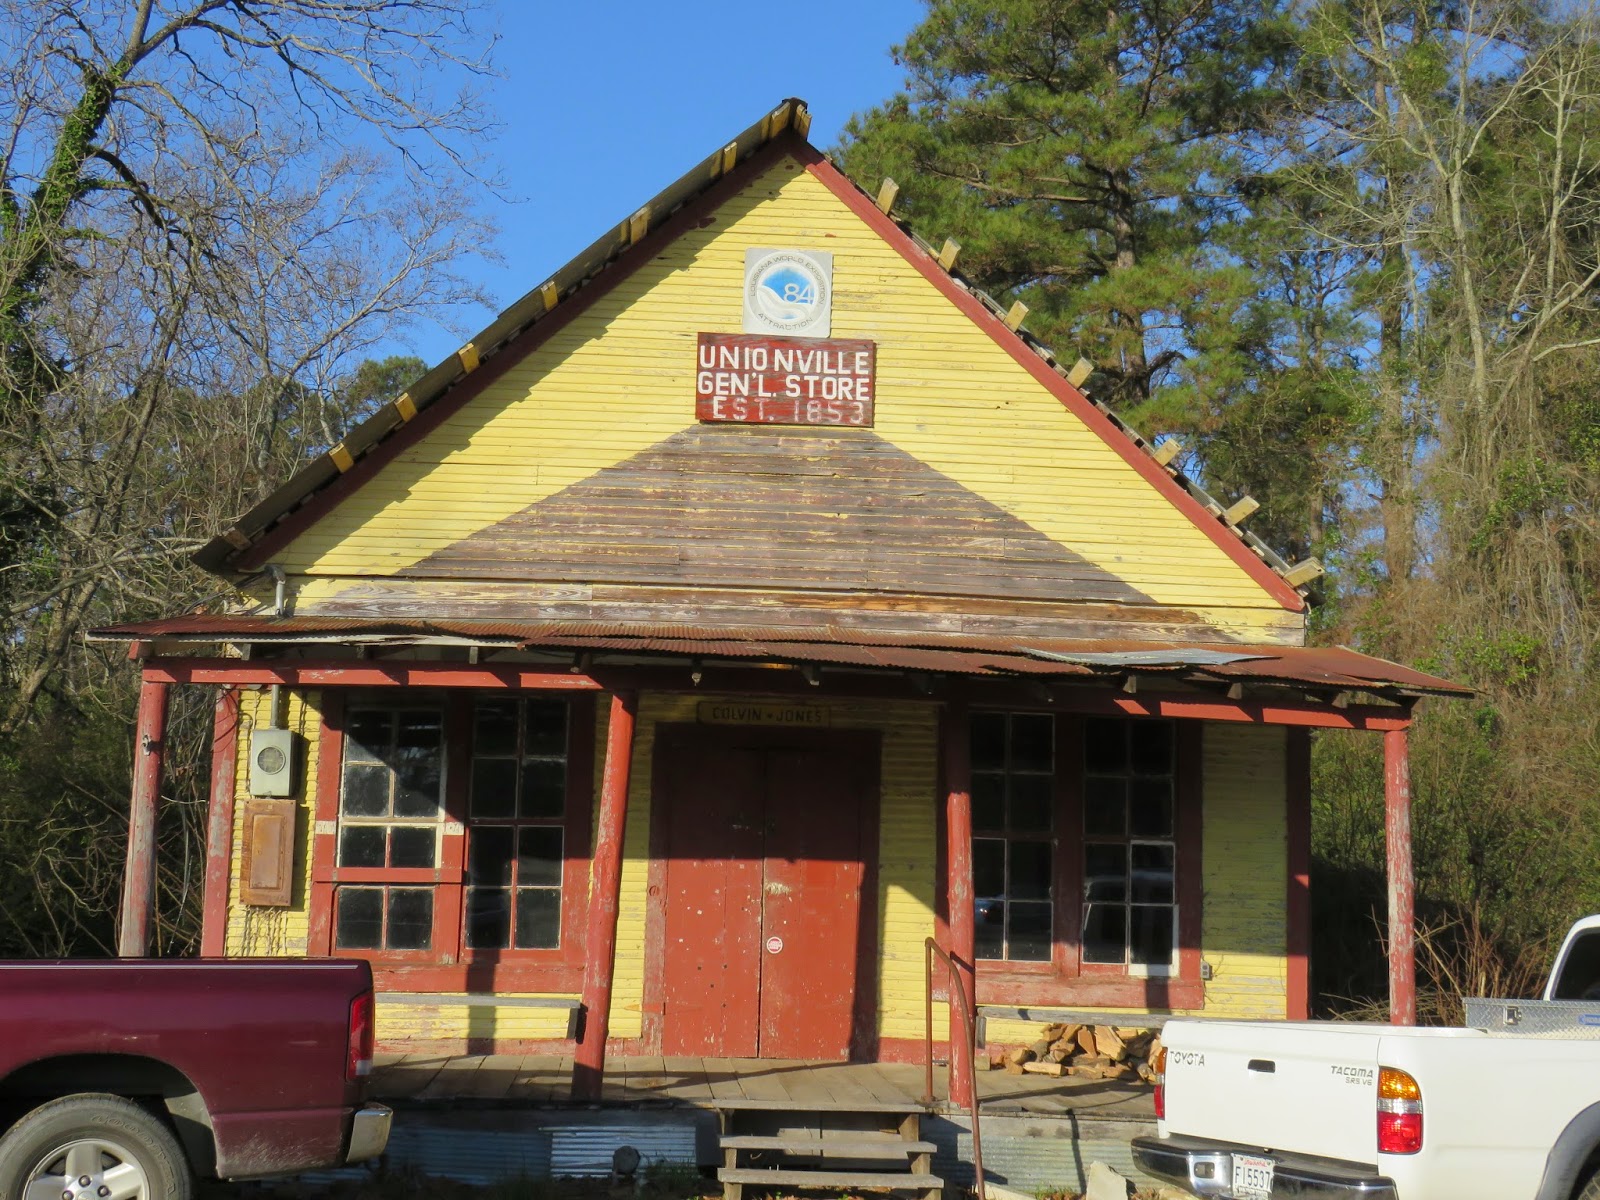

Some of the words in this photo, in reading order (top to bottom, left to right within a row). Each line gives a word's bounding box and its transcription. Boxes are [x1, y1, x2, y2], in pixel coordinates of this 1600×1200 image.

[751, 260, 773, 297] LOUISIANA
[773, 255, 804, 264] WORLD
[805, 263, 828, 305] EXPOSITION
[783, 283, 814, 304] 84
[758, 312, 814, 331] ATTRACTION
[700, 345, 869, 375] UNIONVILLE
[698, 371, 777, 397] GEN'L.
[785, 375, 870, 401] STORE
[713, 396, 775, 421] EST.
[794, 400, 864, 423] 1853
[712, 706, 762, 721] COLVIN
[775, 709, 822, 723] JONES
[1170, 1051, 1205, 1066] TOYOTA
[1331, 1065, 1374, 1078] TACOMA
